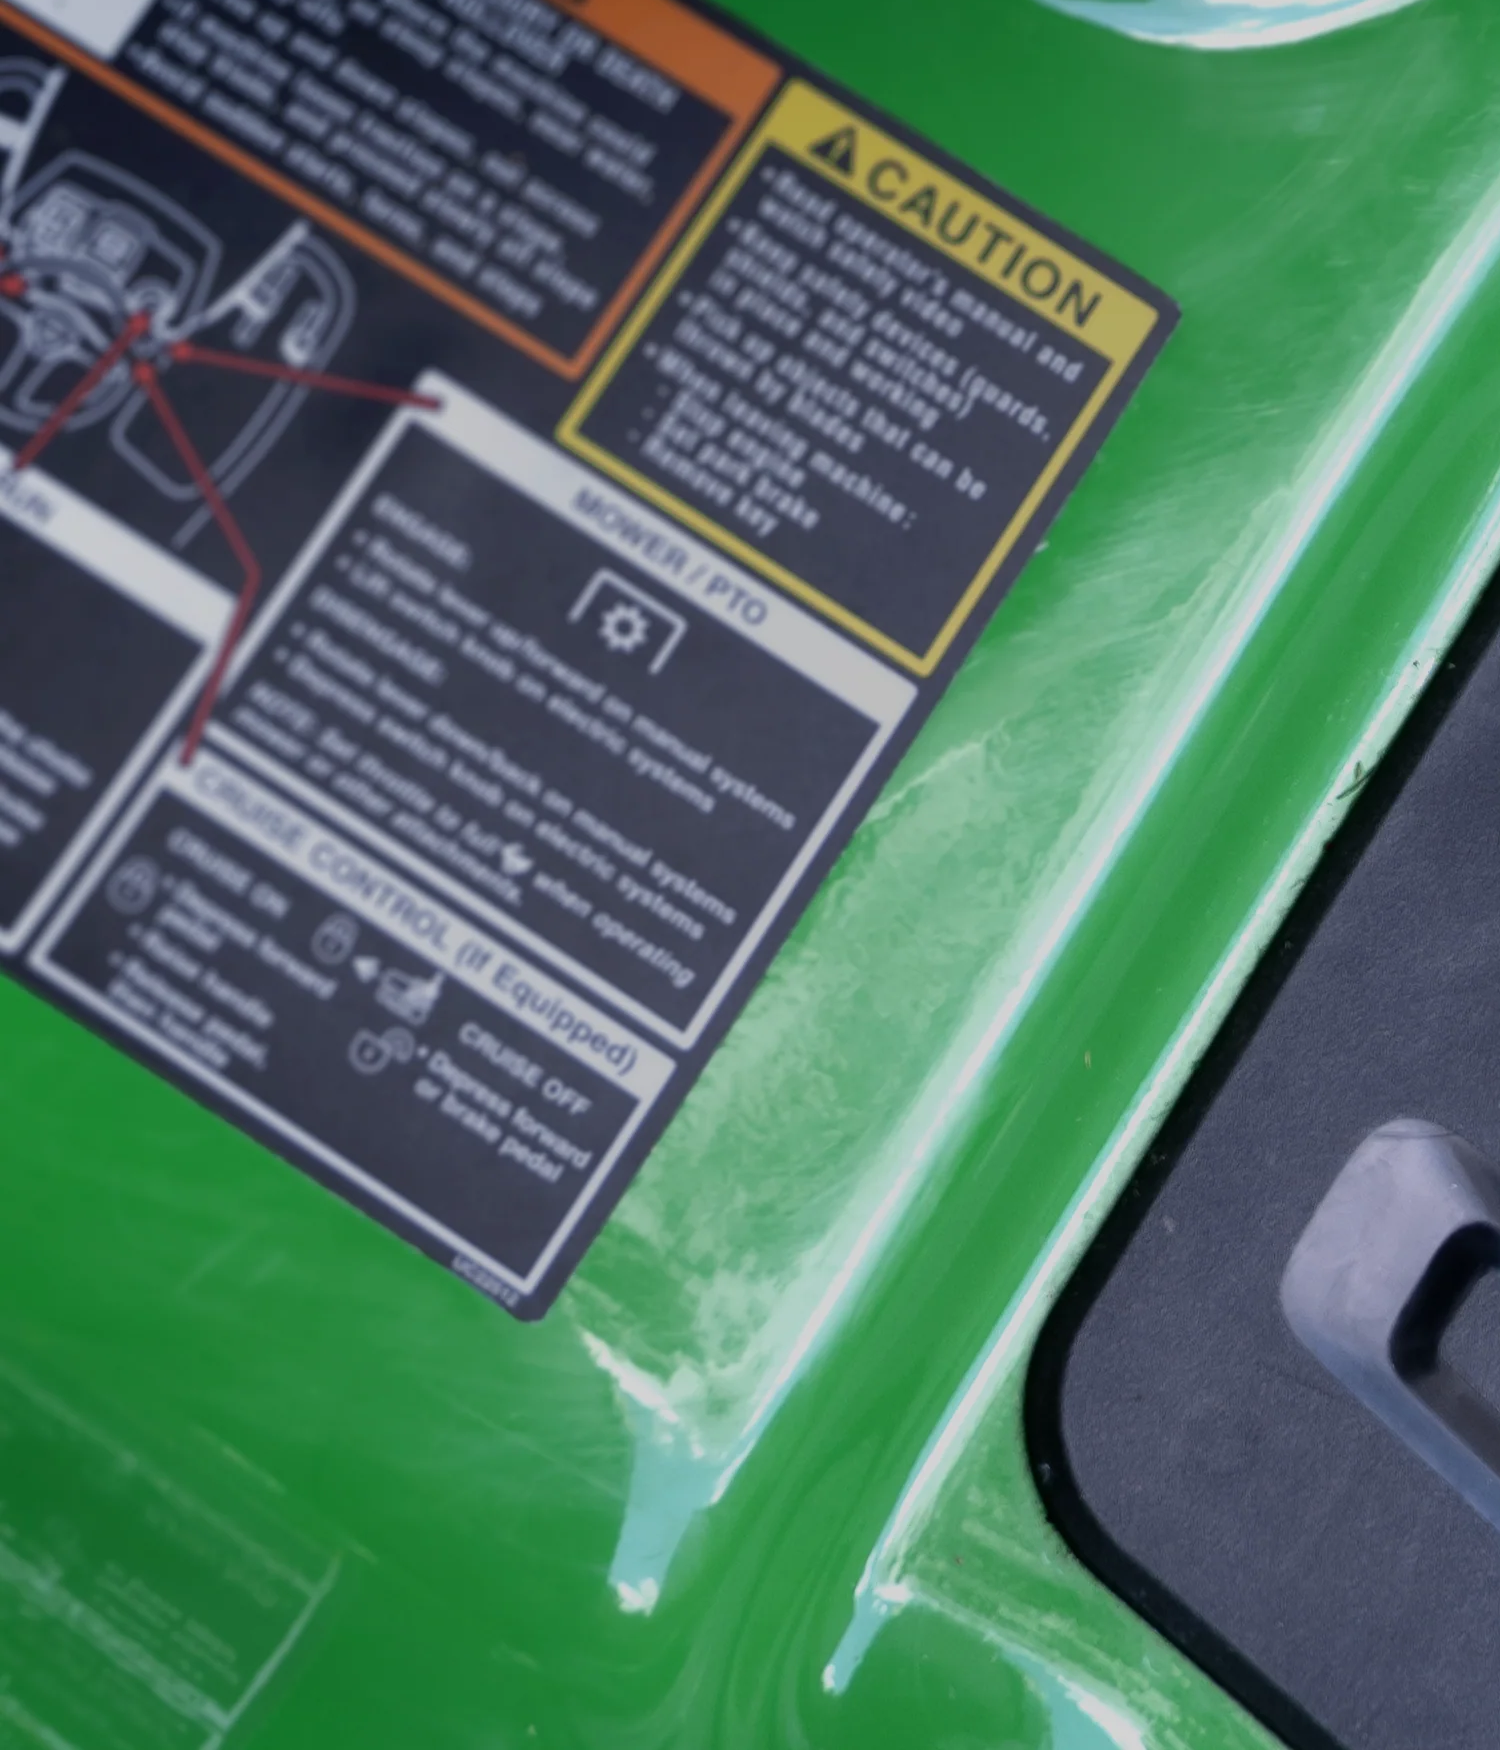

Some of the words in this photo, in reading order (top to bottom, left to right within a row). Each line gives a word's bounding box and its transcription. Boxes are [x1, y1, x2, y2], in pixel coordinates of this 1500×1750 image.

[864, 157, 1103, 329] CAUTION
[949, 288, 1039, 353] manual
[1035, 344, 1085, 384] and
[572, 487, 690, 576] MOWER
[702, 572, 770, 627] PTO
[627, 746, 717, 815] systems
[709, 765, 797, 832] systems
[615, 873, 706, 941] systems
[649, 859, 738, 926] systems
[308, 840, 466, 952] CONTROL
[490, 961, 639, 1078] Equipped)
[591, 912, 697, 990] operating
[426, 1049, 513, 1119] Depress
[510, 1106, 594, 1171] forward
[458, 1021, 545, 1089] CRUISE
[540, 1076, 593, 1116] OFF
[439, 1089, 503, 1144] brake
[497, 1135, 565, 1184] pedal
